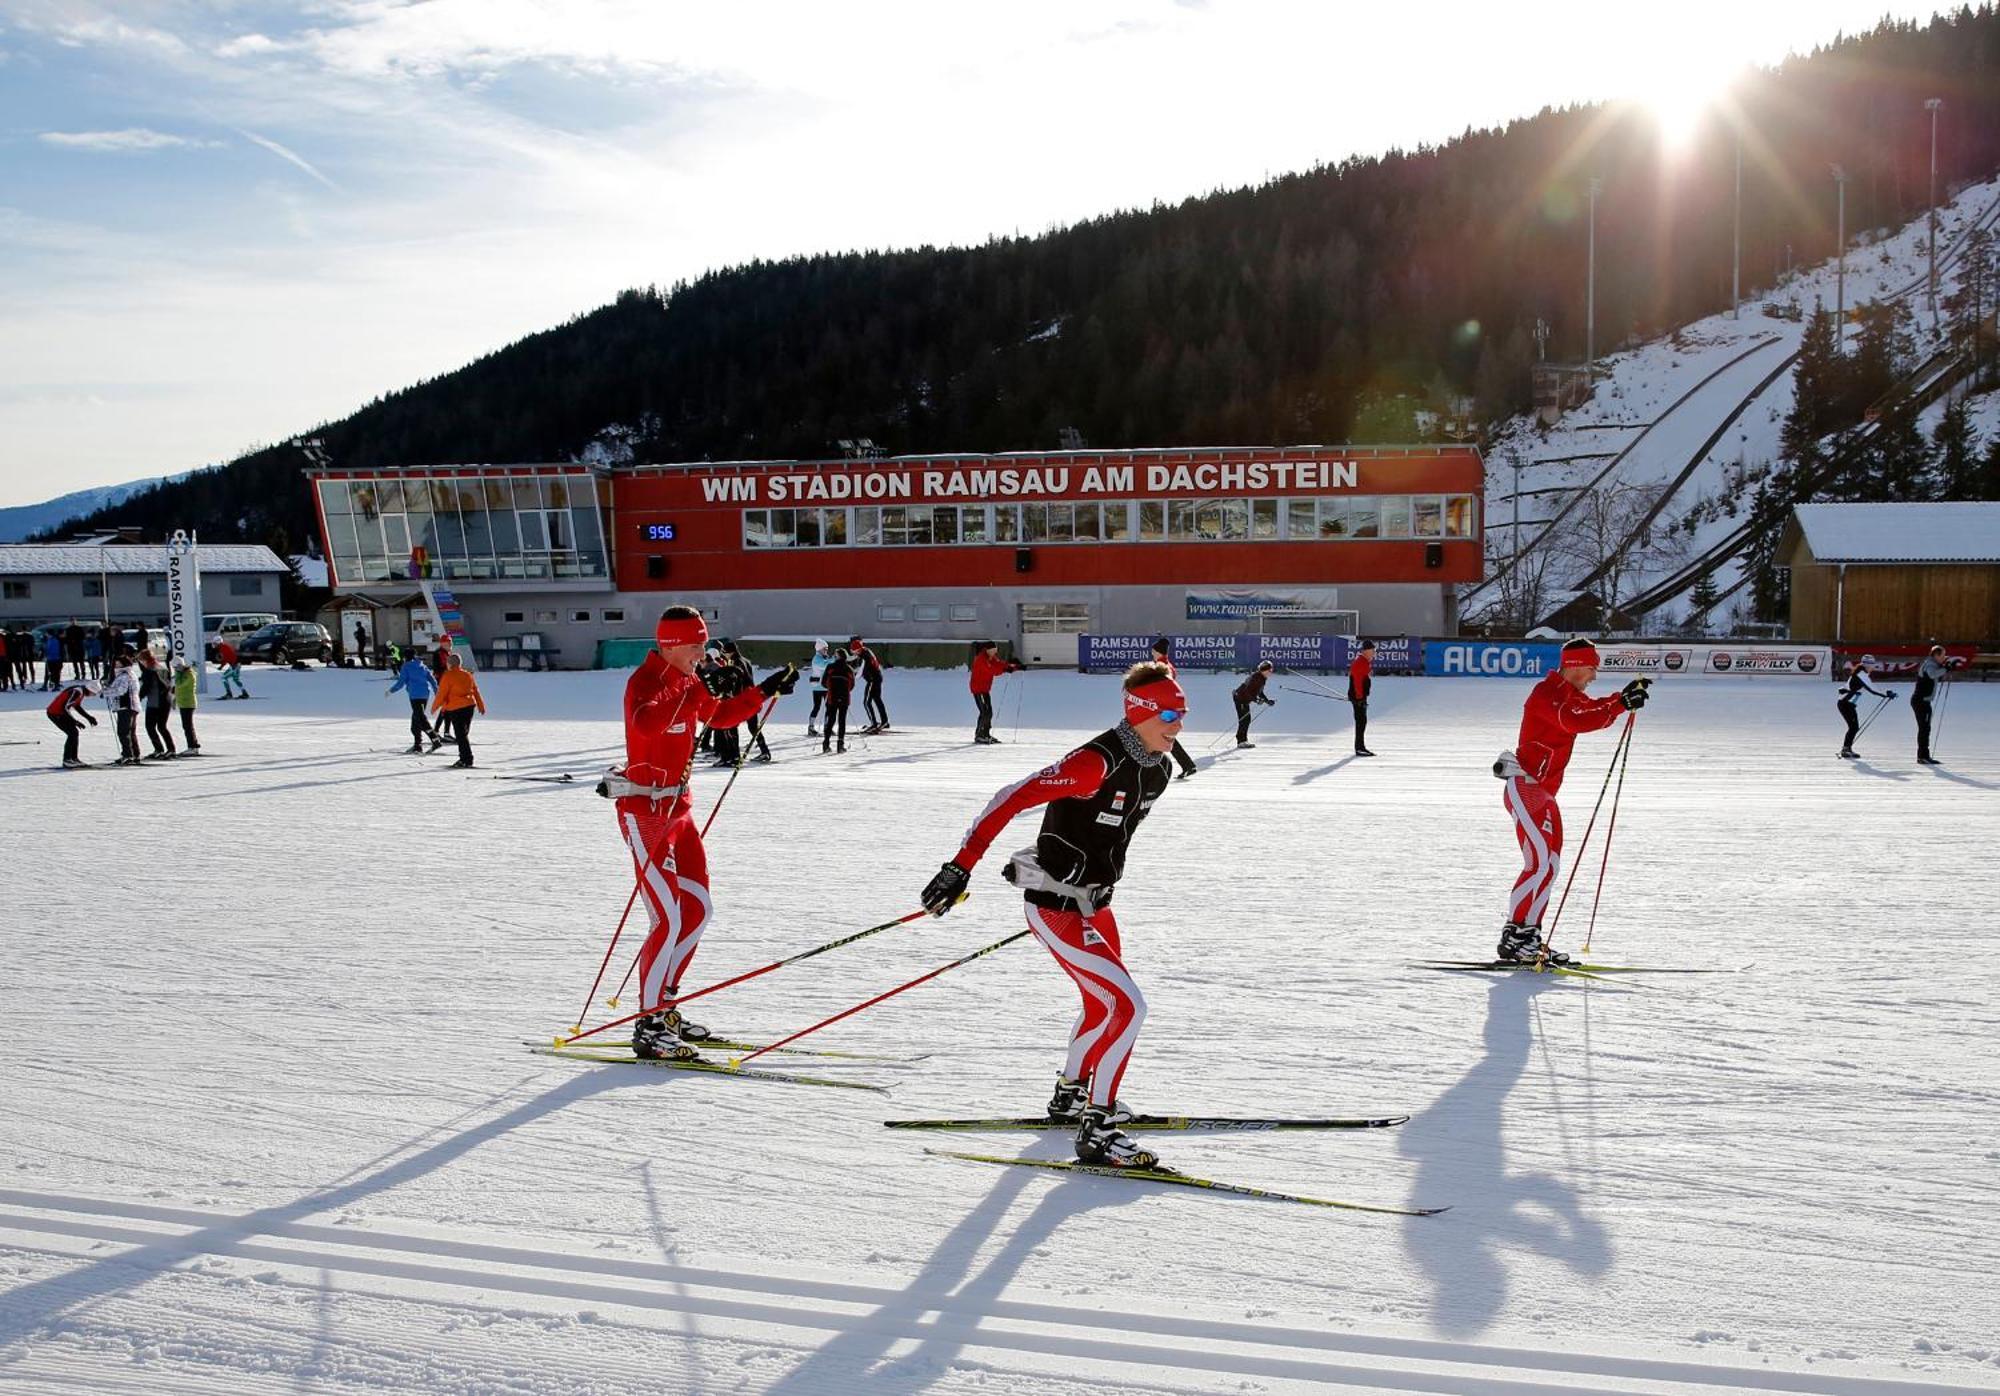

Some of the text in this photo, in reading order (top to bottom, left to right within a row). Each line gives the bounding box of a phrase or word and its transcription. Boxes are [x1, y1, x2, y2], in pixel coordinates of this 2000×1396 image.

[701, 461, 1358, 502] WM STADION RAMSAU AM DACHSTEIN
[1091, 637, 1149, 648] RAMSAU
[1175, 636, 1235, 648] RAMSAU
[1260, 636, 1321, 648] RAMSAU
[1090, 650, 1149, 660] DACHSTEIN
[1175, 649, 1235, 660] DACHSTEIN
[1260, 650, 1321, 660] DACHSTEIN
